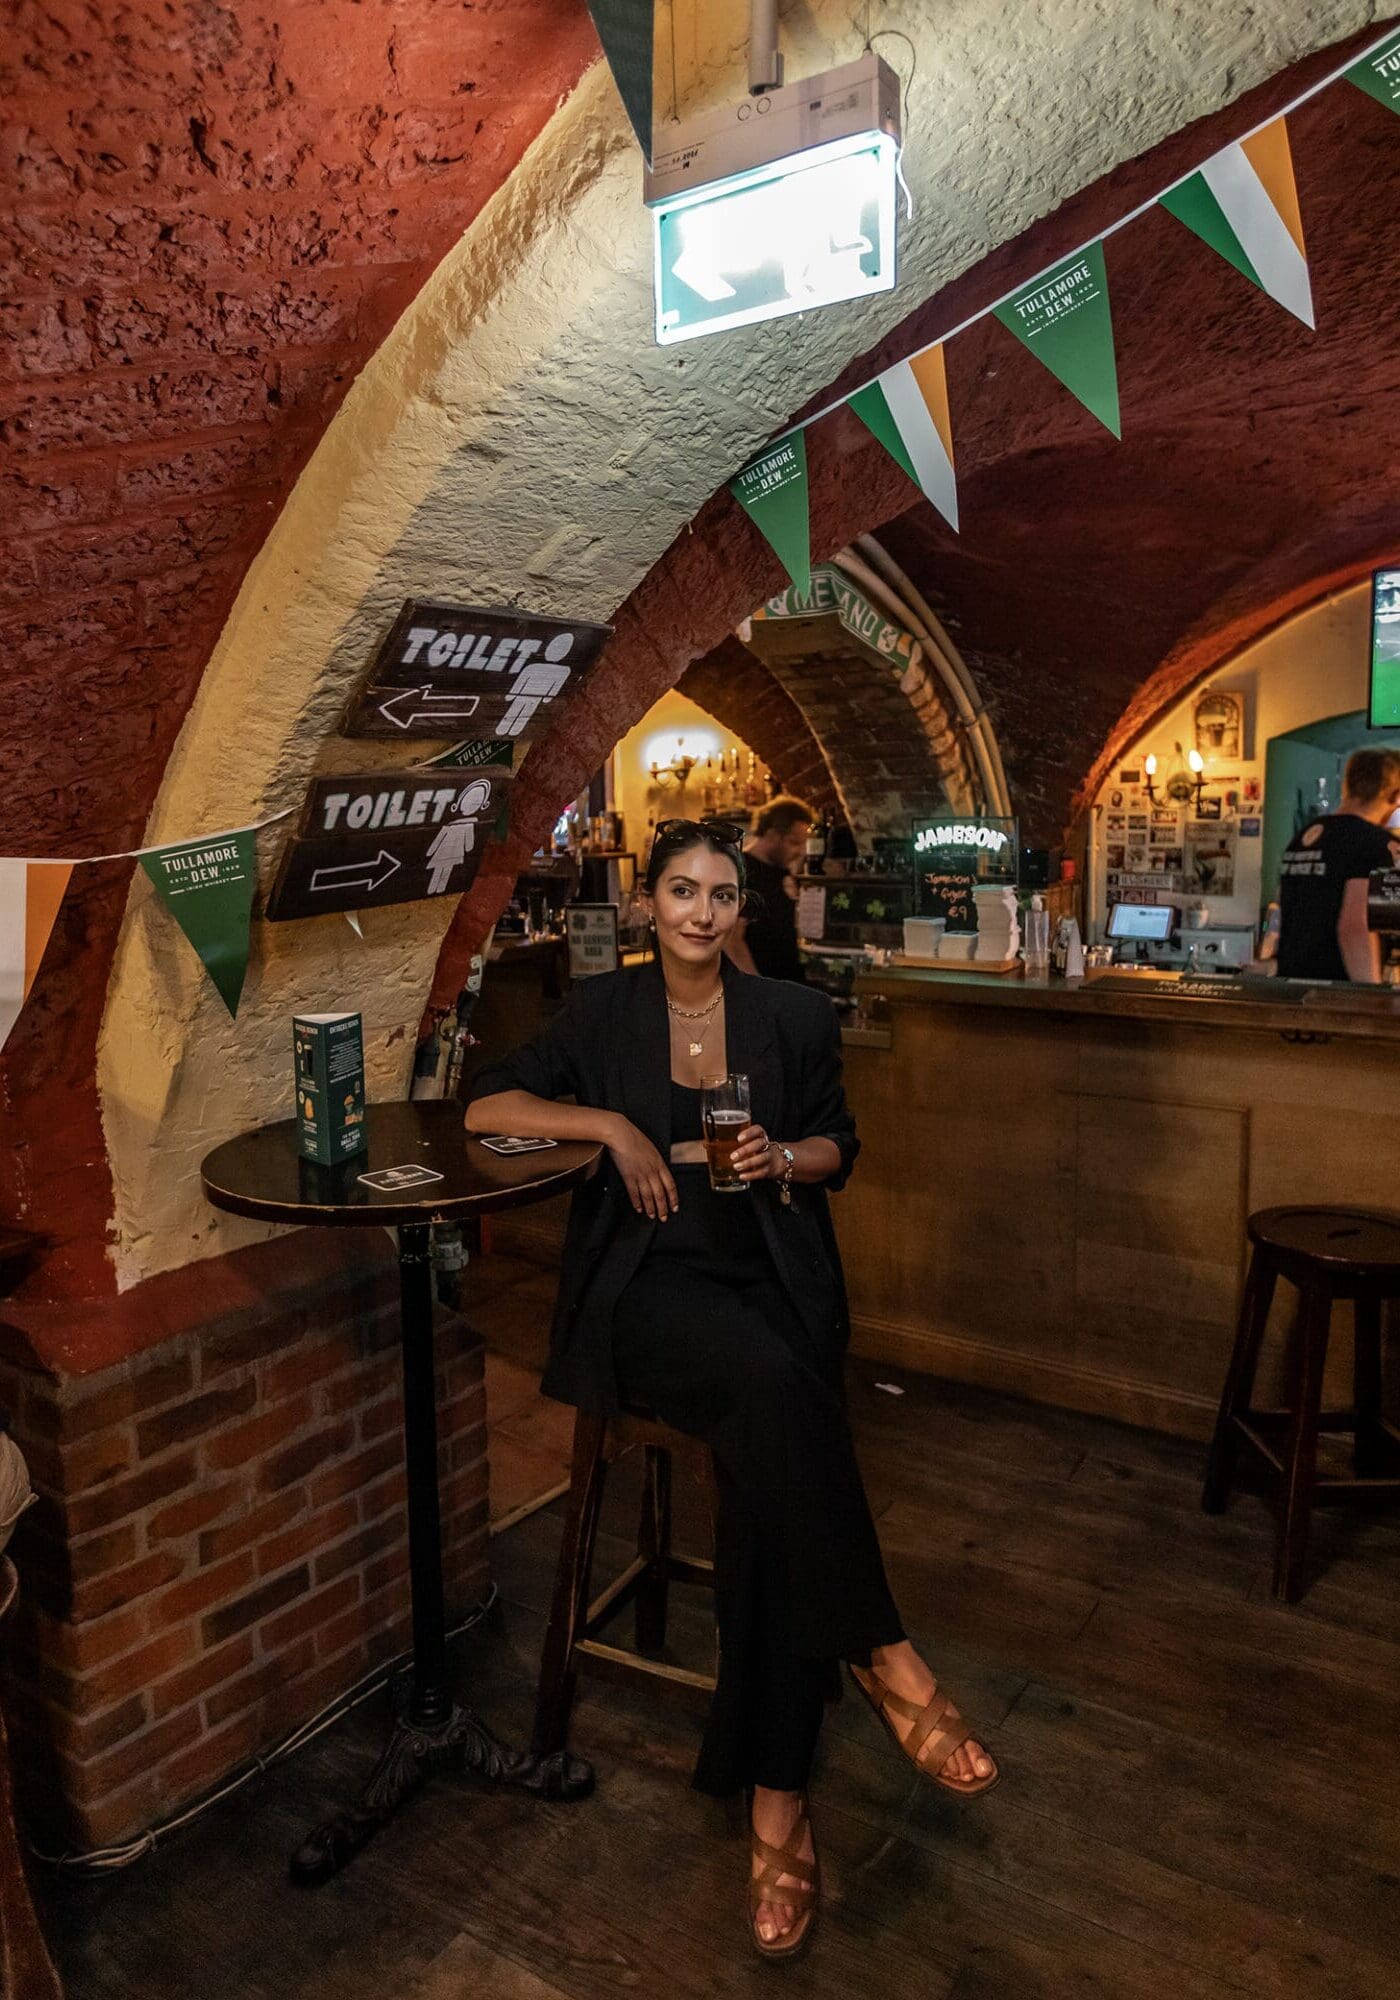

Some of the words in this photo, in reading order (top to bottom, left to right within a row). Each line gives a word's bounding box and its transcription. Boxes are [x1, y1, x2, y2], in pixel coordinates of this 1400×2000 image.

[1016, 265, 1091, 318] TULLAMORE
[739, 448, 795, 486] TULLAMORE
[401, 627, 542, 674] TOILET
[323, 789, 456, 830] TOILET
[914, 825, 1007, 852] JAMESON
[162, 846, 239, 873] TULLAMORE
